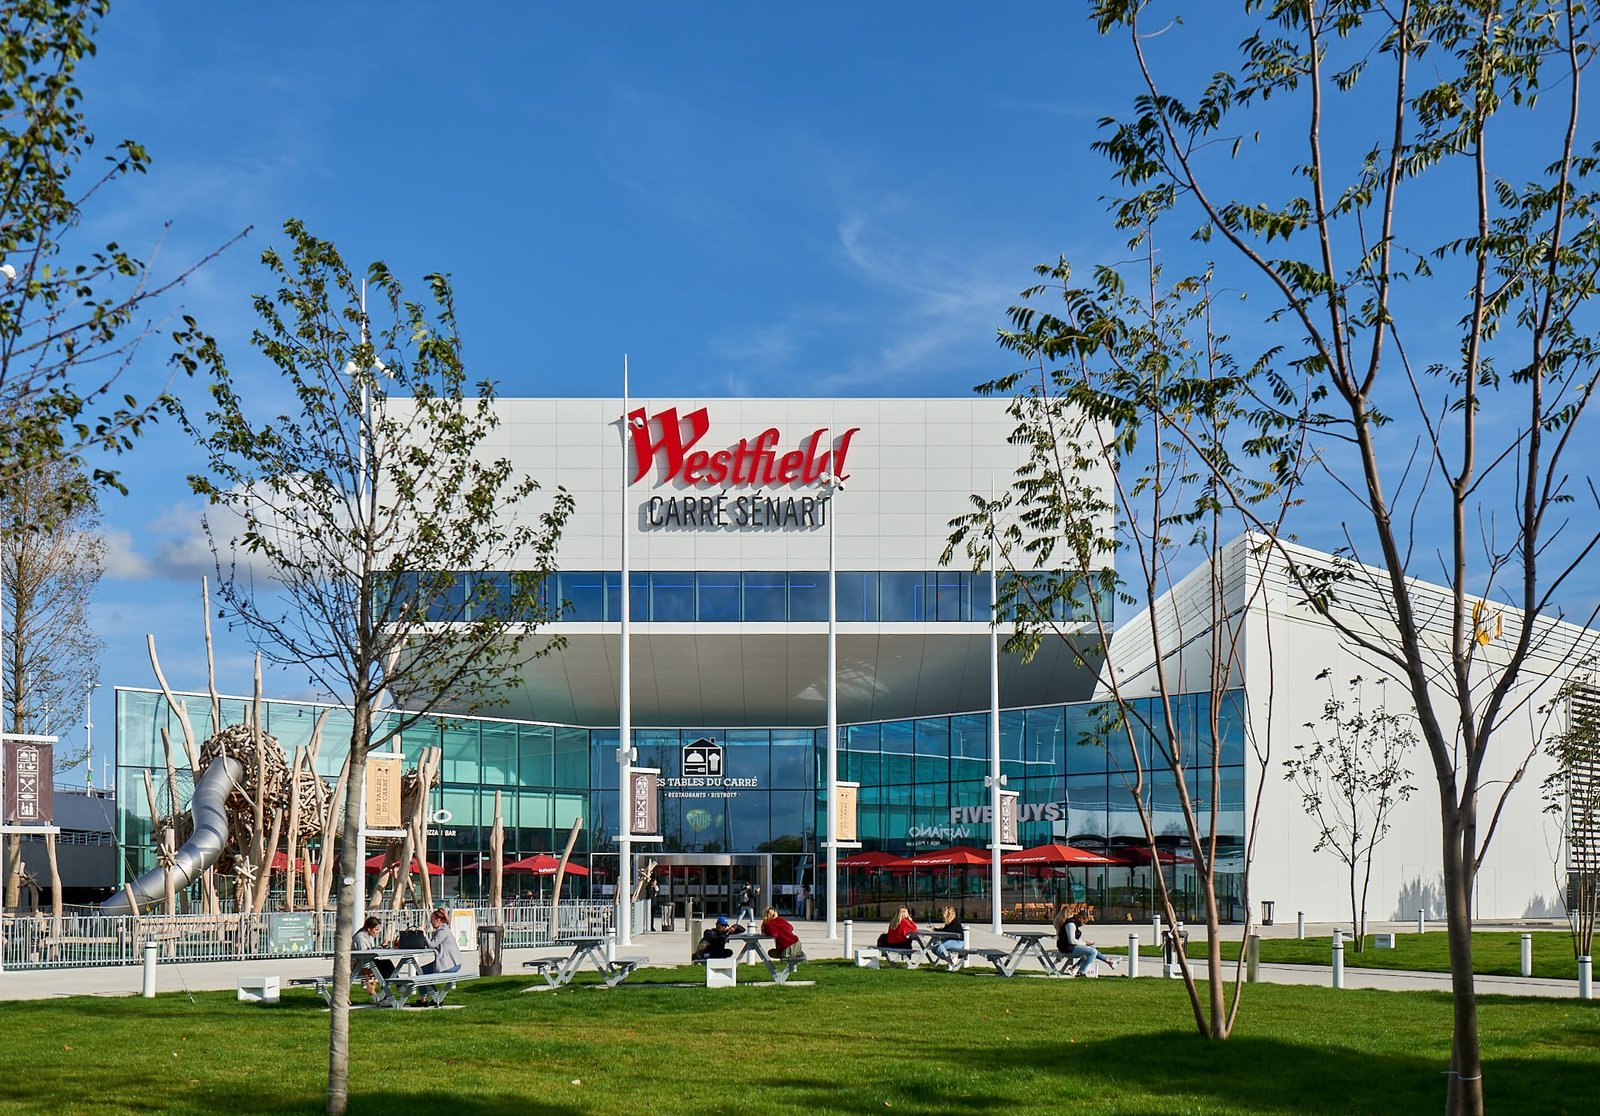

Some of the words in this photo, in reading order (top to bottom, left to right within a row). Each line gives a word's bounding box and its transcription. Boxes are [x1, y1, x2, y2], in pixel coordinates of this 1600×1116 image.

[620, 407, 860, 484] Westfield
[649, 489, 728, 526] CARRÉ
[736, 489, 830, 526] SÉNART
[656, 778, 665, 787] ES
[667, 778, 704, 787] TABLES
[706, 778, 721, 787] DU
[723, 776, 758, 787] CARRÉ
[951, 805, 992, 824] FIVE
[1017, 803, 1061, 822] UYS
[444, 829, 457, 837] BAR
